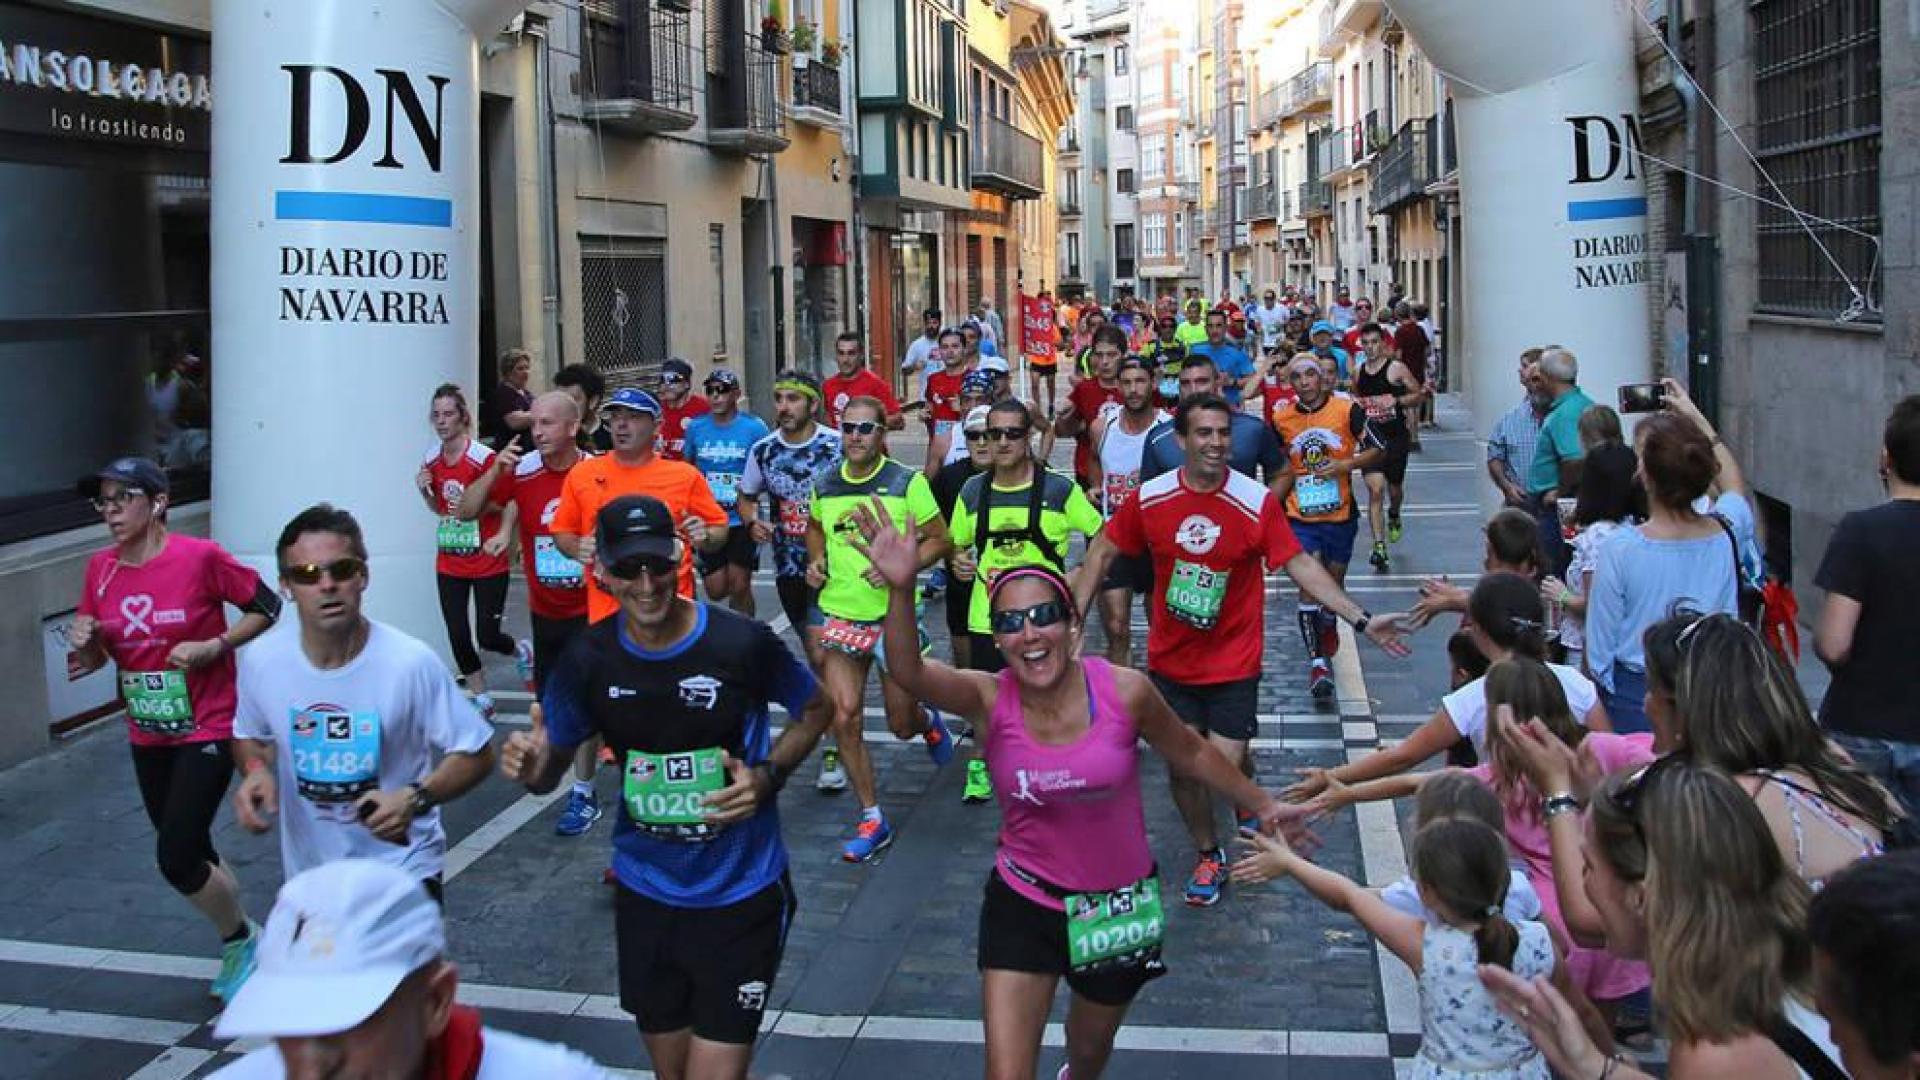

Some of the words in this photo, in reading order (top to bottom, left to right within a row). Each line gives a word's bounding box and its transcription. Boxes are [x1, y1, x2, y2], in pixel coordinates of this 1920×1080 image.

[52, 108, 72, 129] la
[81, 113, 185, 142] trastienda
[279, 65, 450, 172] DN
[1574, 234, 1640, 259] DIARIO
[280, 247, 402, 279] DIARIO
[411, 252, 448, 280] DE
[1576, 261, 1648, 289] NAVAR
[280, 288, 449, 324] NAVARRA
[294, 750, 375, 775] 21484
[630, 792, 720, 818] 1020
[1076, 918, 1161, 957] 10204
